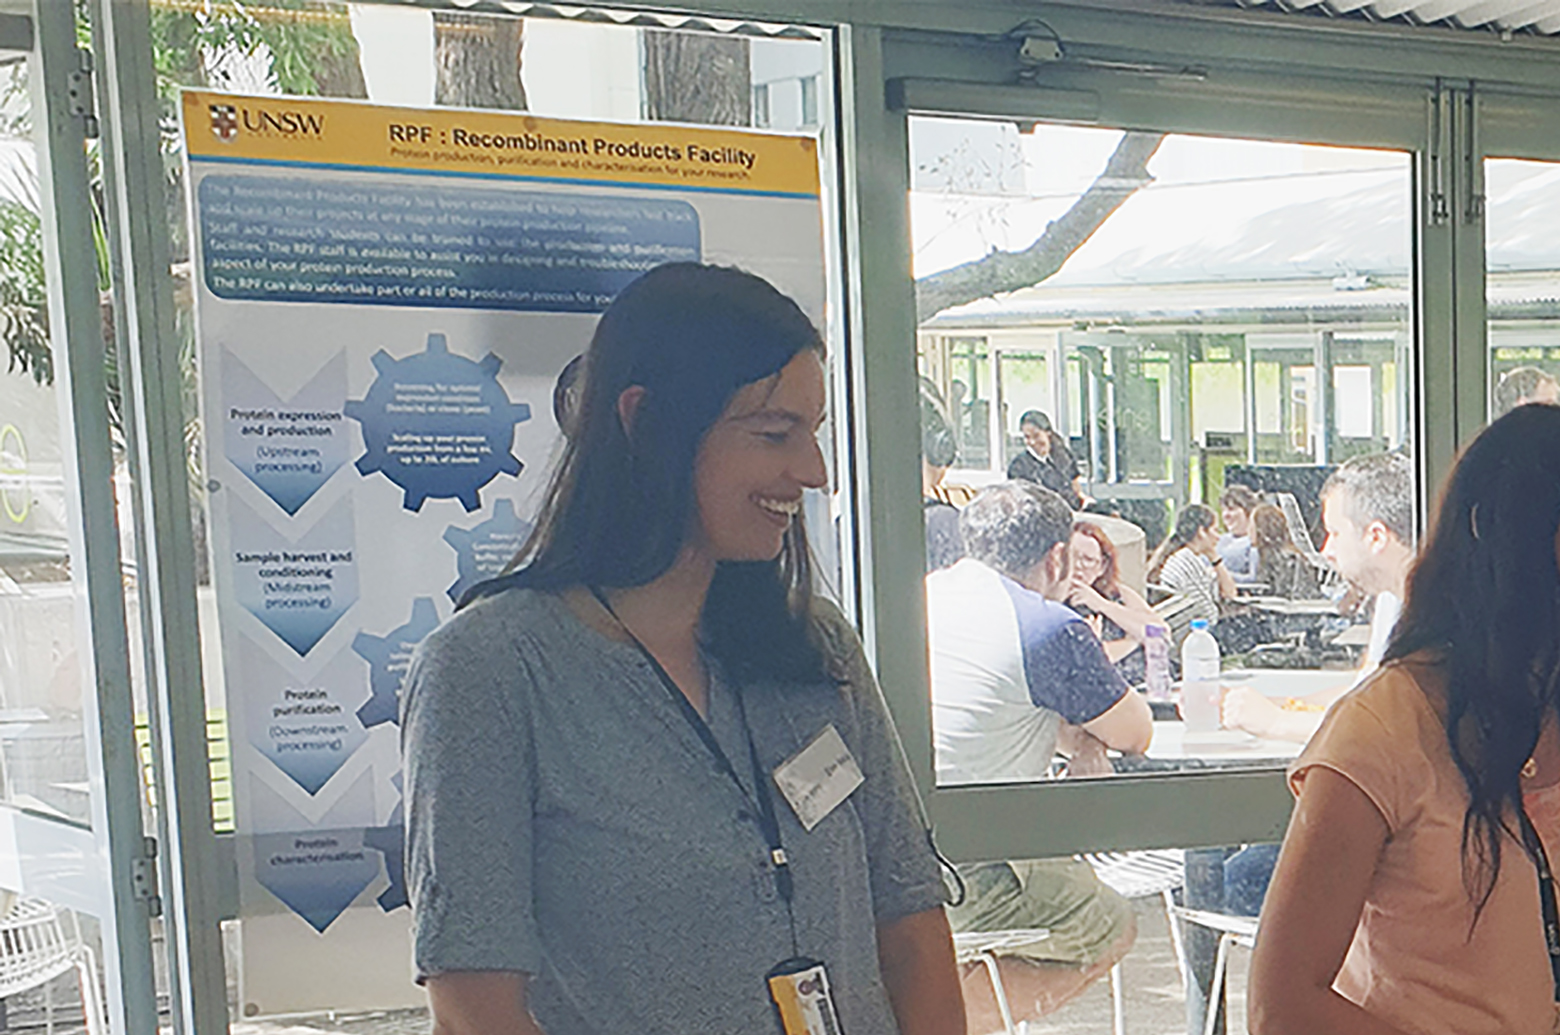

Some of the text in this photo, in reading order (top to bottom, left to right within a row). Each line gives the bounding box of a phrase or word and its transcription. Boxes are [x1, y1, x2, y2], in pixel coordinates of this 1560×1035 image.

[242, 110, 324, 134] UNSW
[389, 124, 432, 144] RPF
[453, 128, 588, 154] Recombinant
[593, 138, 682, 161] Products
[687, 145, 756, 169] Facility
[230, 408, 342, 422] Protein expression
[241, 424, 333, 436] and production
[256, 446, 321, 458] (Upstream
[255, 460, 323, 474] processing)
[236, 551, 352, 564] Sample harvest and
[258, 566, 333, 579] conditioning
[263, 582, 332, 594] (Midstream
[265, 596, 332, 610] processing)
[284, 688, 328, 700] Protein
[273, 703, 342, 718] purification
[268, 725, 349, 738] (Downstream
[276, 738, 342, 753] processing)
[294, 838, 338, 849] Protein
[270, 852, 364, 866] characterisation
